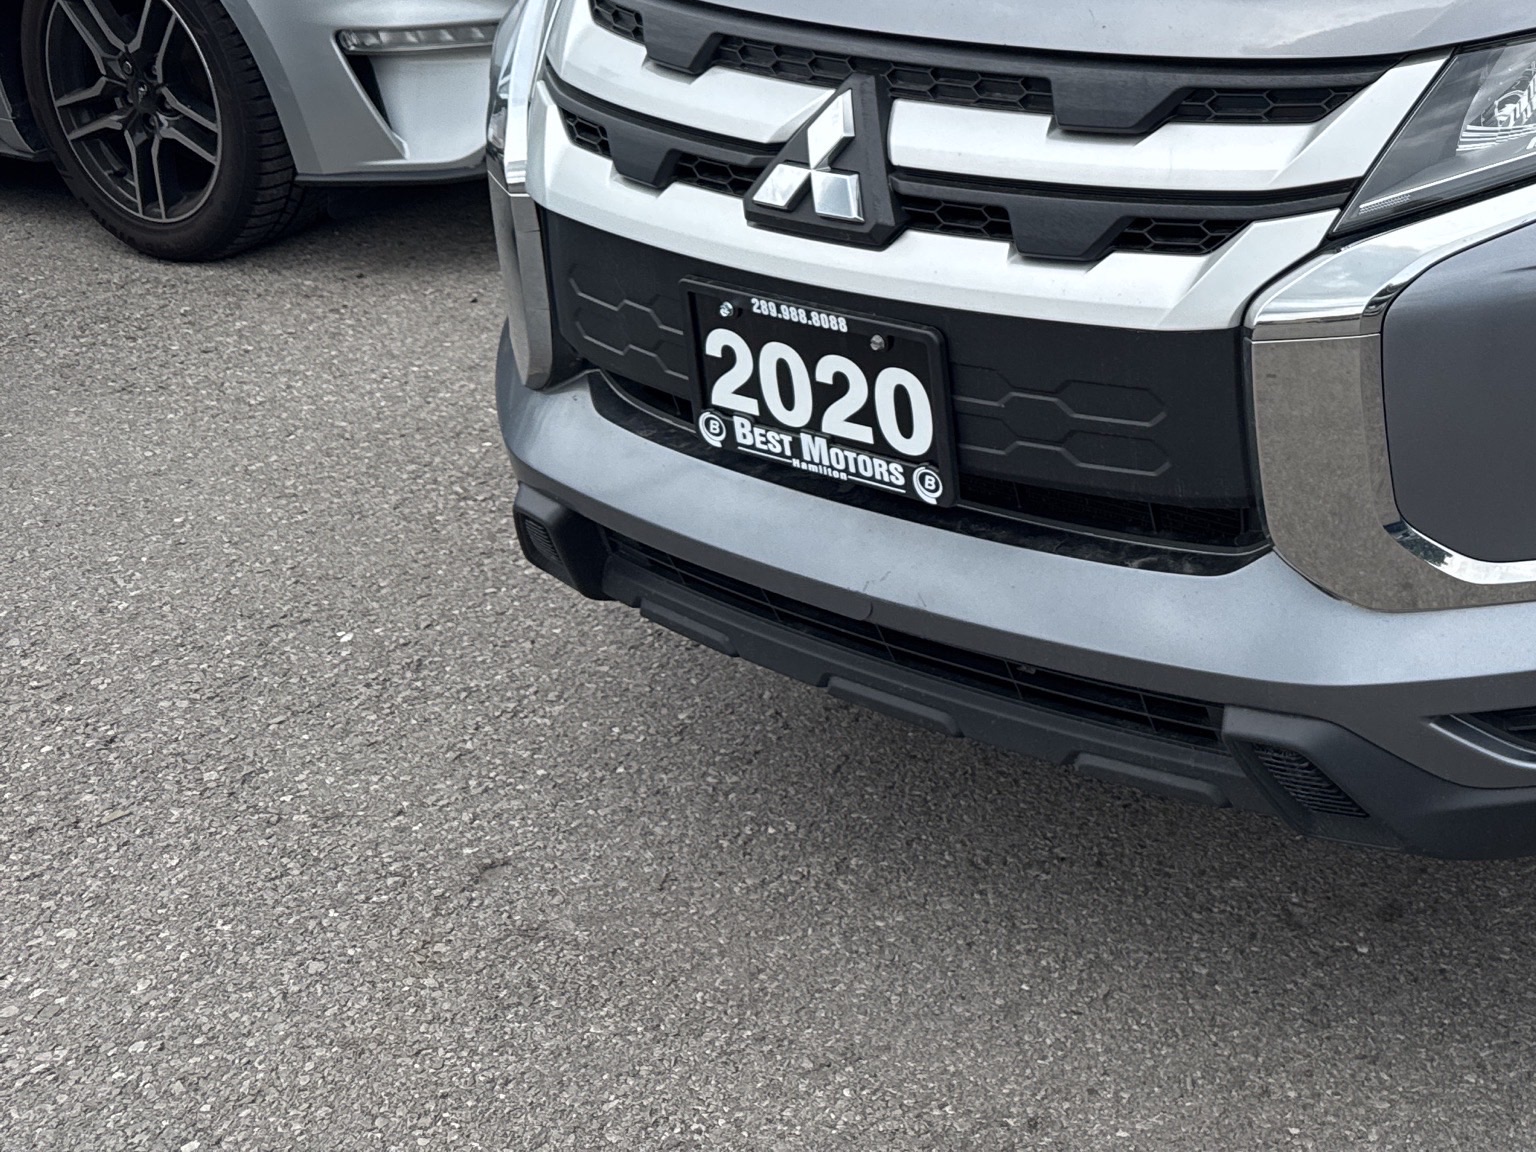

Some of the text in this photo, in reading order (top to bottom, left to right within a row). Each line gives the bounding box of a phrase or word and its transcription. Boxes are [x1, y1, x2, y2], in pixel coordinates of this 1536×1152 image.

[751, 298, 848, 333] 289.988.8088
[705, 328, 933, 456] 2020
[733, 415, 906, 486] BEST MOTORS
[792, 458, 848, 481] Hamilton
